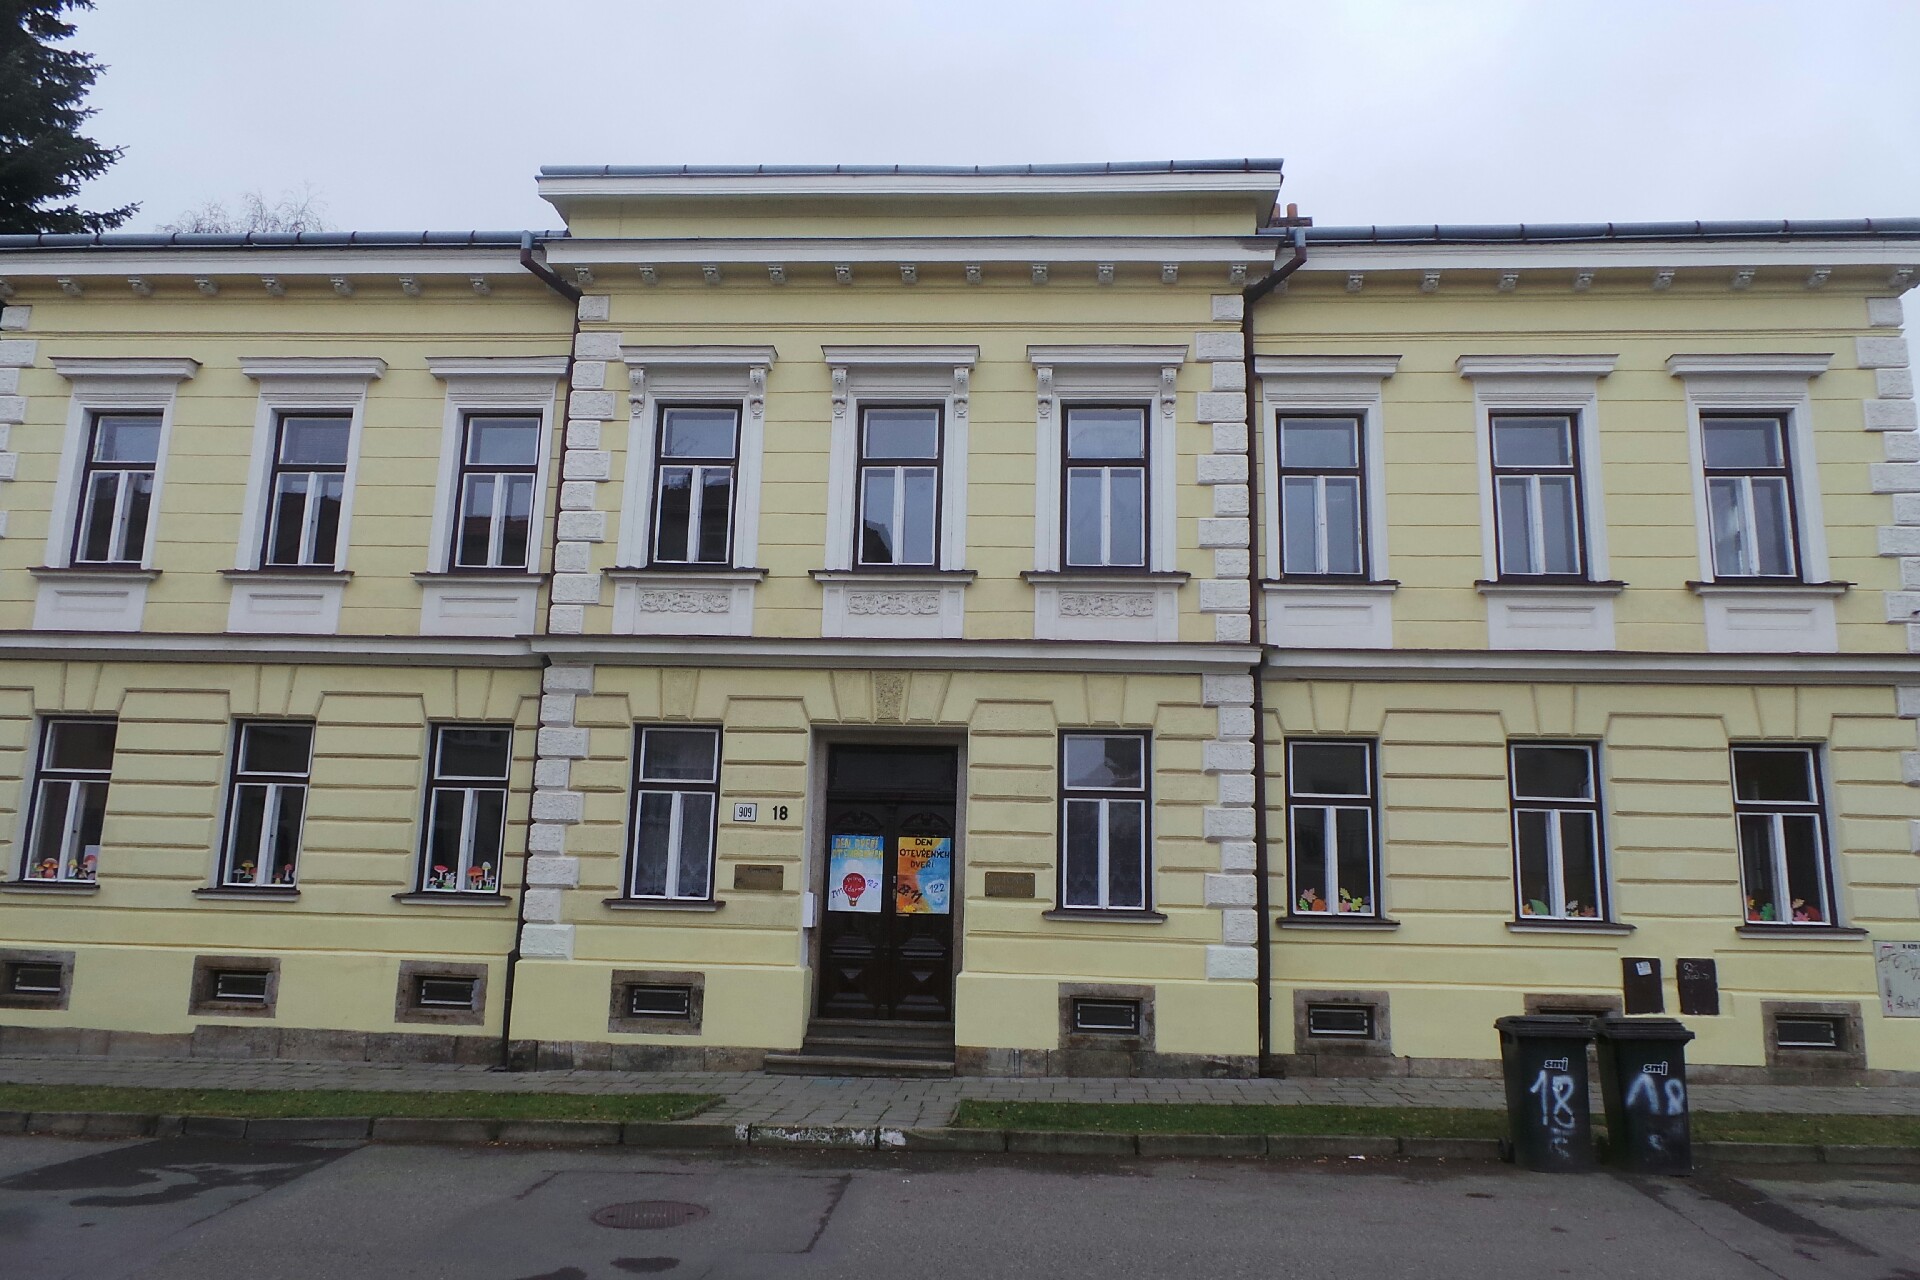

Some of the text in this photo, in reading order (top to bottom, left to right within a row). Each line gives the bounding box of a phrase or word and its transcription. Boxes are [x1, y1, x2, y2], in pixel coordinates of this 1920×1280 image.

[738, 806, 752, 818] 909
[772, 805, 788, 820] 18
[915, 838, 933, 846] DEN
[899, 847, 950, 859] OTEVŘENÝCH
[1544, 1057, 1569, 1071] smj
[1643, 1061, 1668, 1076] smj
[1530, 1070, 1575, 1129] 18
[1625, 1072, 1685, 1117] 18
